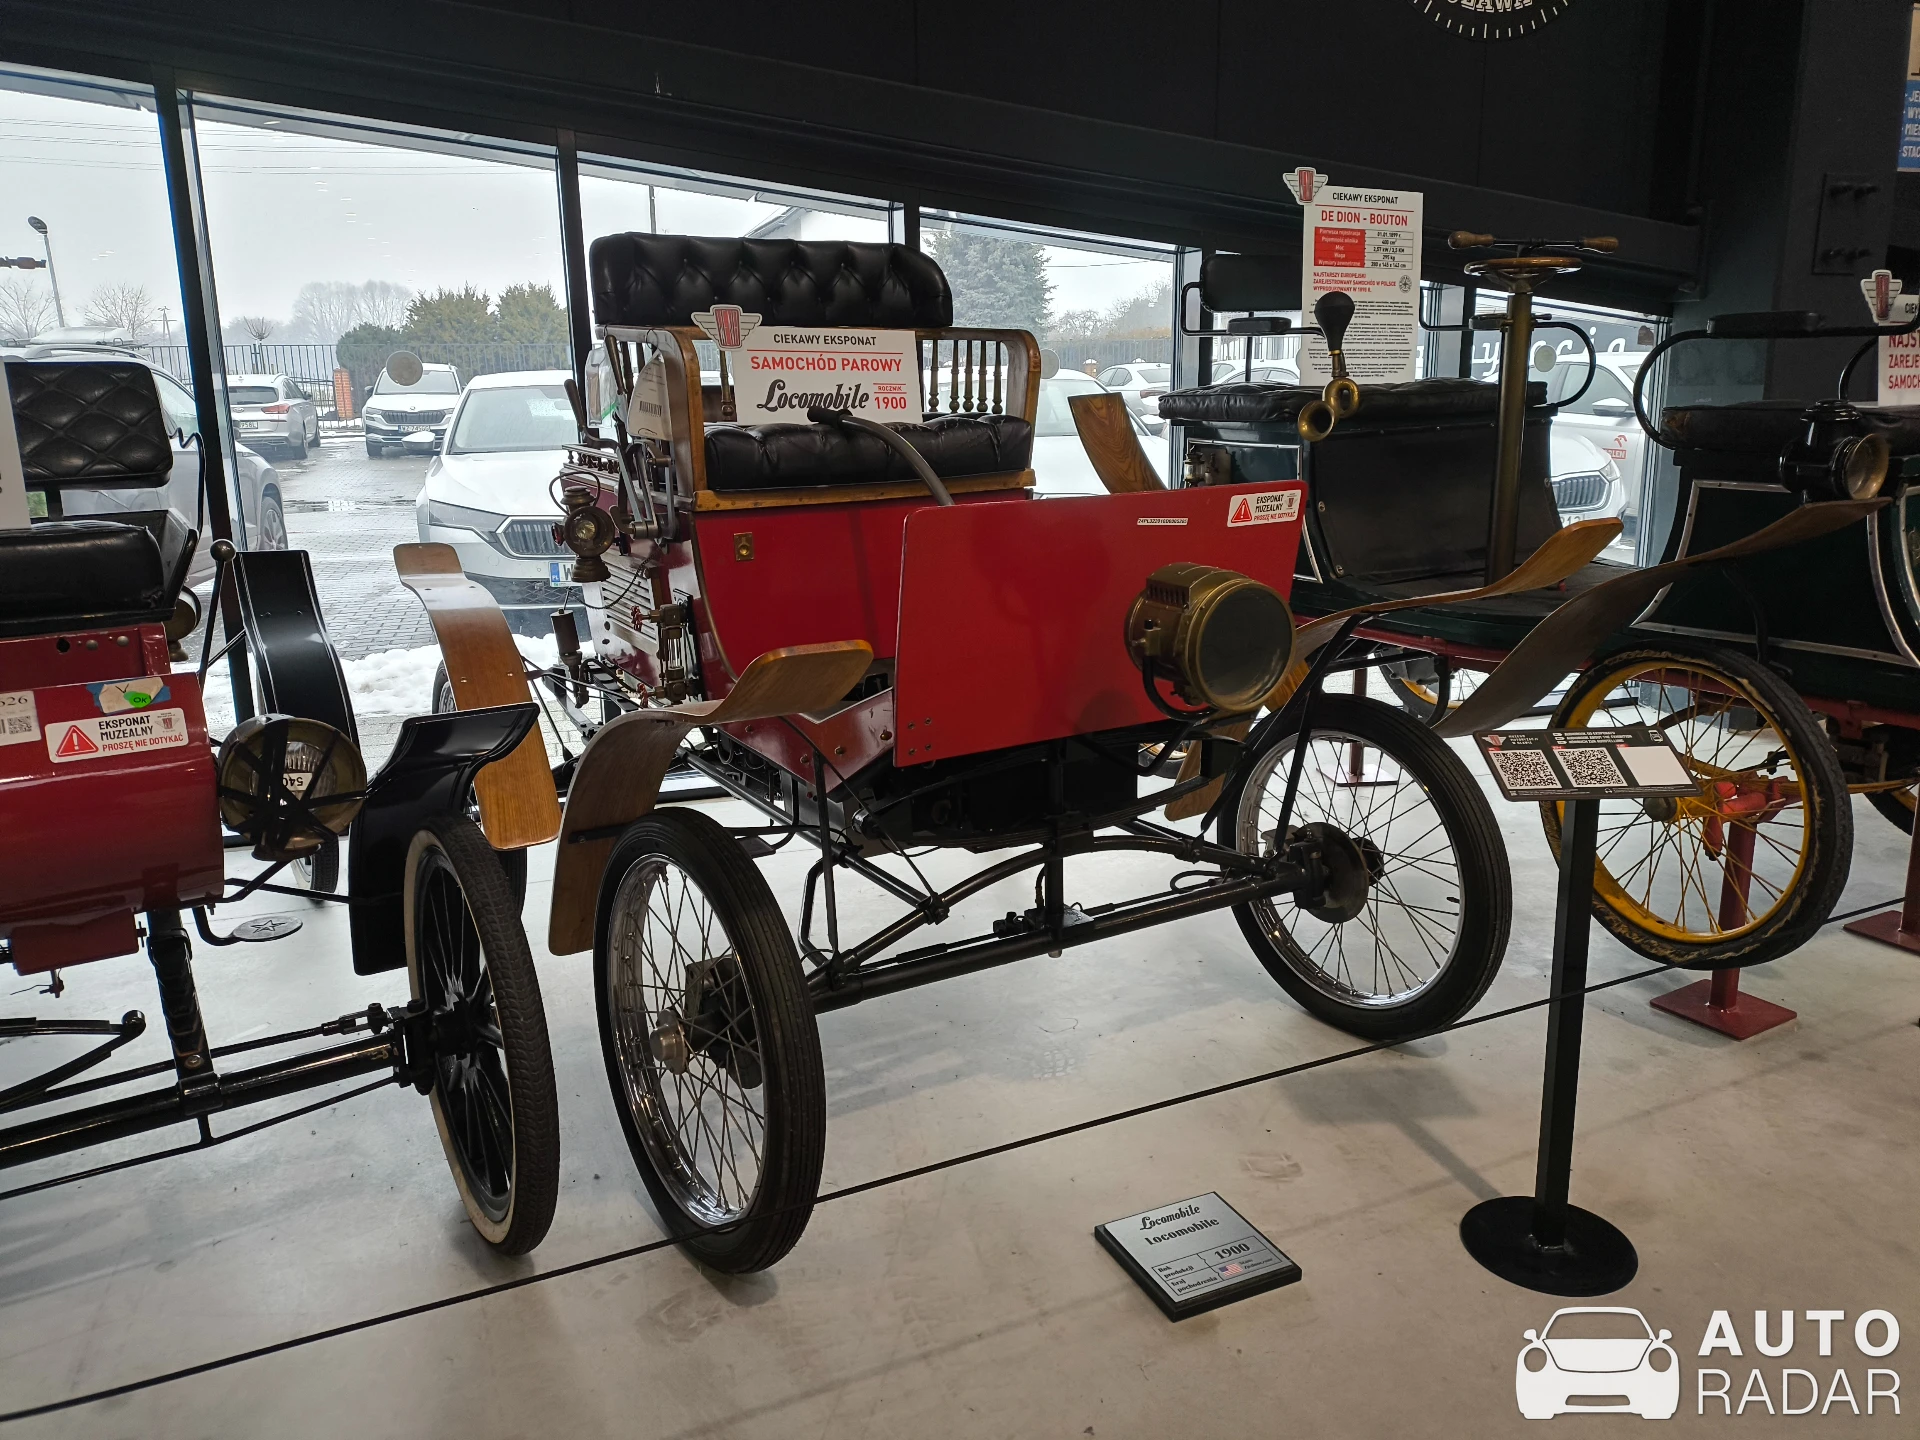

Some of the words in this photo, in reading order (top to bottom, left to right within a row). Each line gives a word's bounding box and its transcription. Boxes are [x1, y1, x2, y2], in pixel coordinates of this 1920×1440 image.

[1332, 192, 1362, 202] CIEKAWY
[1364, 194, 1398, 204] EKSPONAT
[1322, 210, 1334, 222] DE
[1337, 211, 1360, 223] DION
[1370, 213, 1408, 226] BOUTON
[774, 334, 821, 344] CIEKAWY
[824, 335, 876, 346] EKSPONAT
[751, 354, 837, 371] SAMOCHÓD
[842, 358, 902, 372] PAROWY
[756, 379, 870, 412] Locomobile
[874, 396, 907, 409] 1900
[1256, 494, 1284, 504] EKSPONAT
[1255, 503, 1283, 513] MUZEALNY
[1278, 510, 1295, 518] DOTYKAĆ
[99, 715, 150, 730] EKSPONAT
[100, 726, 153, 741] MUZEALNY
[102, 741, 135, 751] PROSZĘ
[135, 739, 148, 747] NIE
[150, 732, 183, 745] DOTYKAĆ
[1139, 1204, 1200, 1230] Locomobile
[1214, 1242, 1250, 1260] 1900
[1164, 1265, 1194, 1279] produkcji
[1171, 1279, 1186, 1287] Kraj
[1177, 1276, 1218, 1293] pochodzenia
